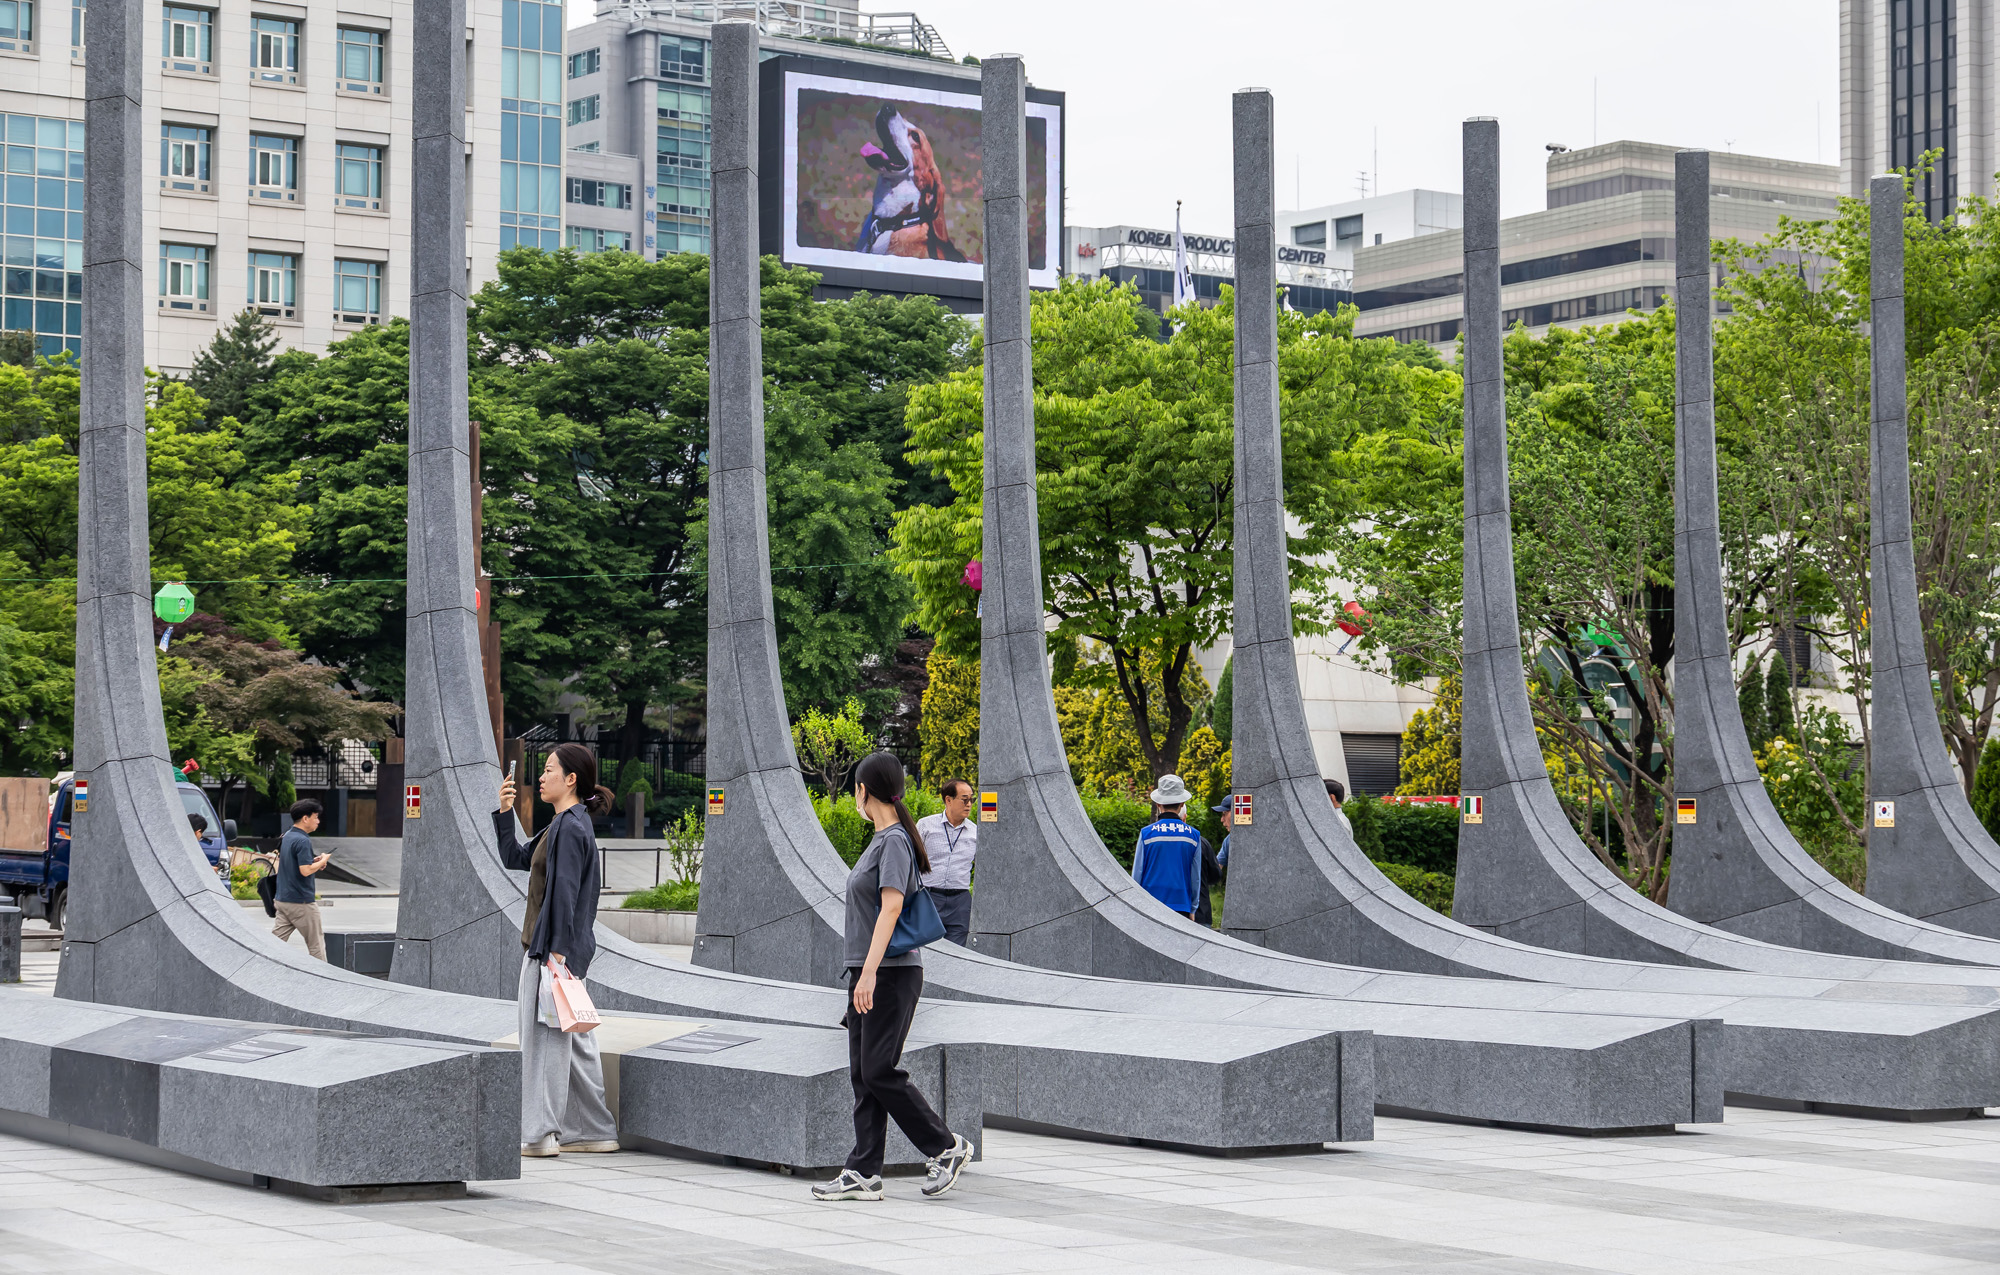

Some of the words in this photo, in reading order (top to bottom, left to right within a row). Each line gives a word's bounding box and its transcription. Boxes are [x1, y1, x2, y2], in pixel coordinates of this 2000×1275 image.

[1128, 229, 1172, 247] KOREA
[1278, 246, 1326, 265] CENTER
[1151, 822, 1192, 834] 서울특별시
